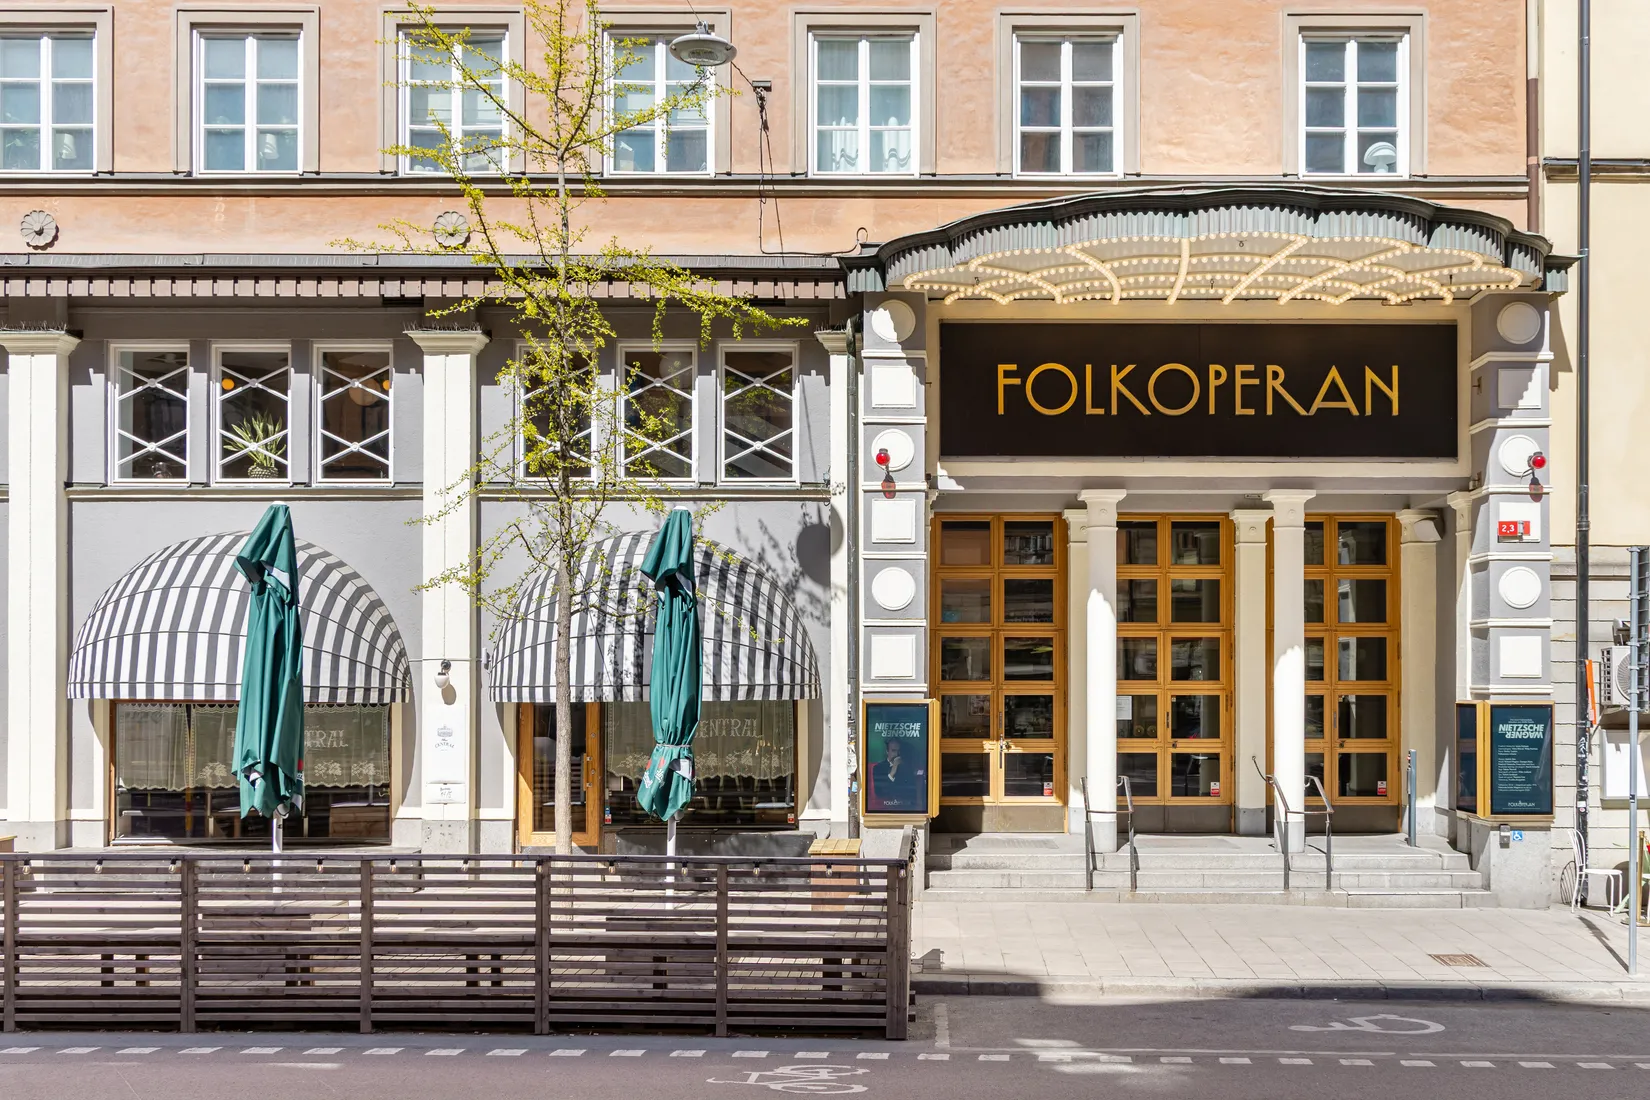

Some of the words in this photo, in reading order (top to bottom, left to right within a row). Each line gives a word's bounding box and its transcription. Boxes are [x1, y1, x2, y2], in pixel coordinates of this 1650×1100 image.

[997, 362, 1399, 416] FOLKOPERAN
[694, 718, 764, 738] ENTRAL
[874, 722, 921, 730] NIETZSCHE
[1498, 724, 1545, 732] NIETZSCHE
[1505, 731, 1544, 739] WAGNER
